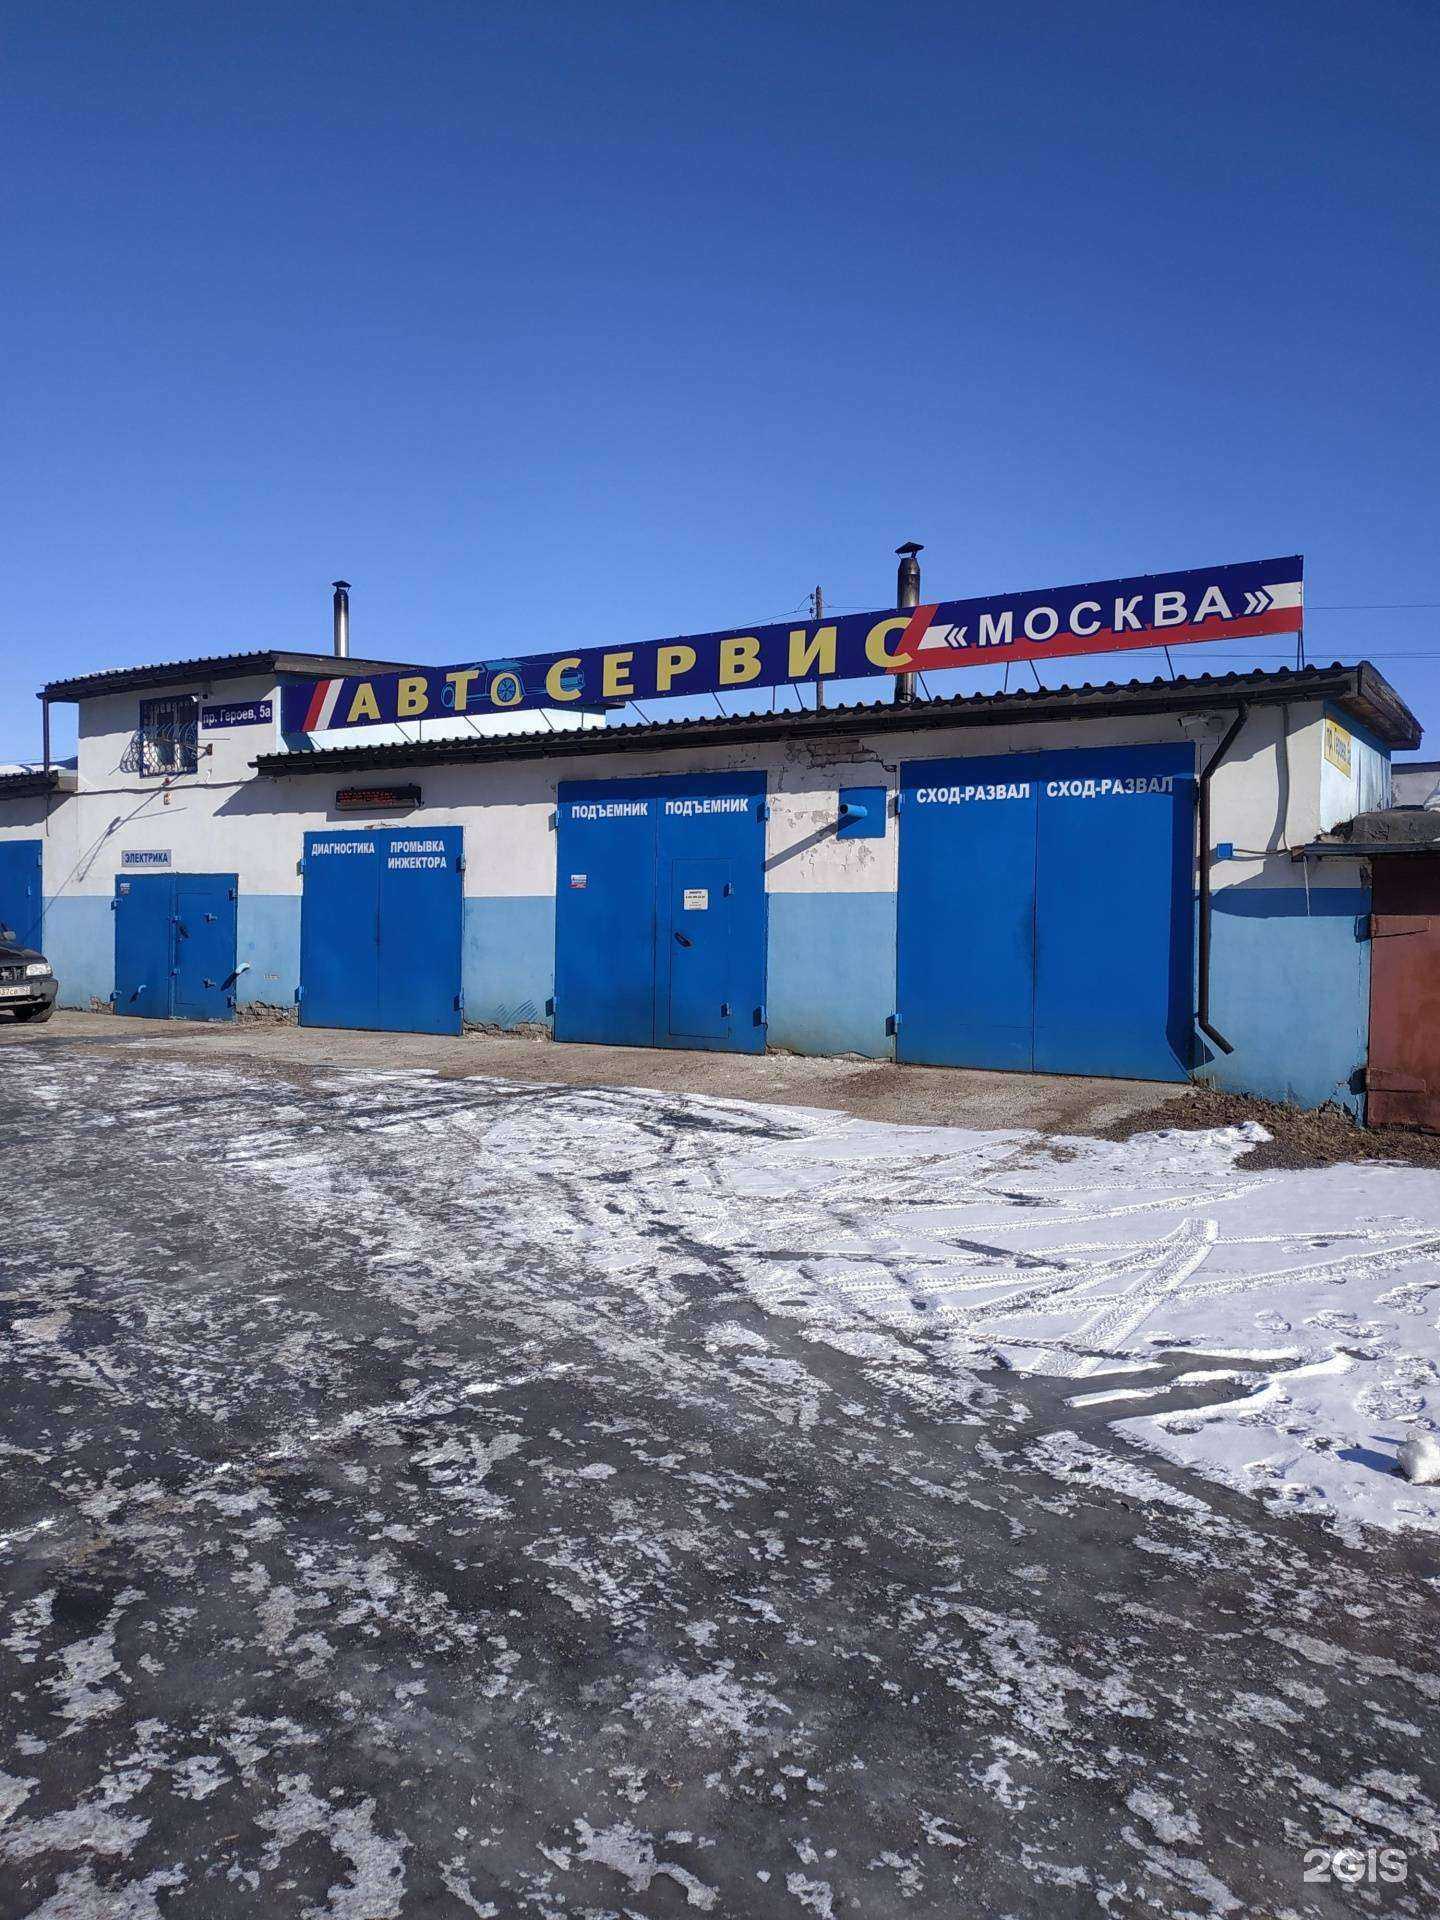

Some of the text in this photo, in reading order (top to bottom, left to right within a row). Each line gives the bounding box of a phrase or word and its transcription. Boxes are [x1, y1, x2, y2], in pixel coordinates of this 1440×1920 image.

[203, 713, 217, 726] пр.
[259, 705, 271, 718] 5а
[916, 782, 1031, 805] СХОД-РАЗВАЛ
[1046, 777, 1174, 799] СХОД-РАЗВАЛ
[571, 803, 648, 820] ПОДЪЕМНИК
[665, 799, 749, 816] ПОДЪЕМНИК
[311, 842, 375, 855] ДИАГНОСТИКА
[390, 840, 445, 853] ПРОМЫВКА
[124, 852, 168, 863] ЭЛЕКТРИКА
[387, 854, 447, 869] ИНЖЕКТОРА
